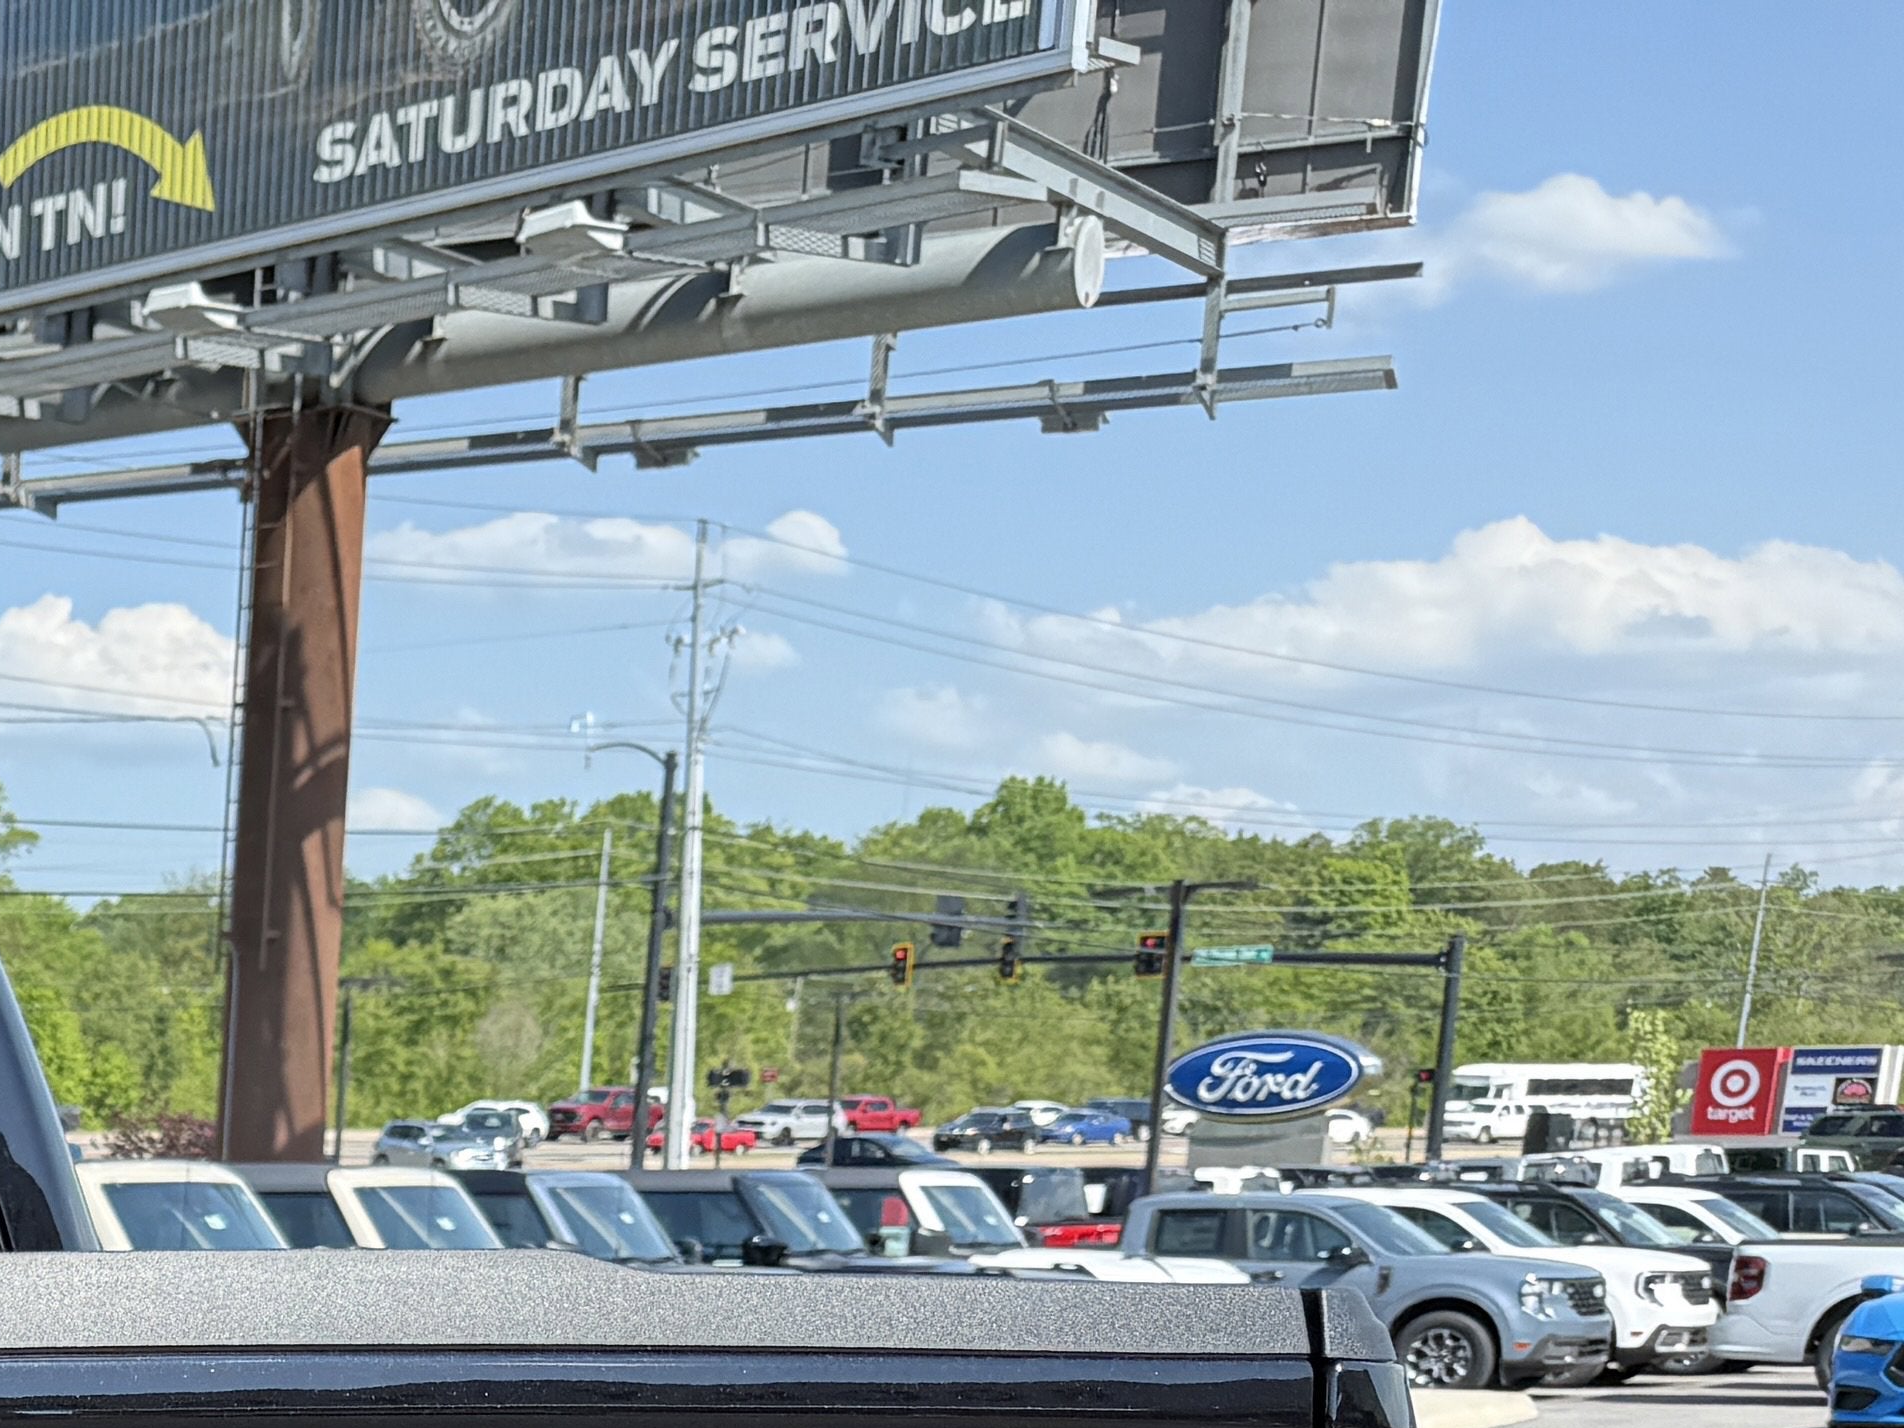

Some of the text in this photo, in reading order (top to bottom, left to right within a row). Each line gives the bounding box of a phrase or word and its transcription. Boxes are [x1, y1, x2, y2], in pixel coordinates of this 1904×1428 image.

[313, 38, 680, 184] SATURDAY
[31, 178, 127, 252] TN!
[1197, 1050, 1324, 1104] Ford
[1706, 1106, 1757, 1124] target
